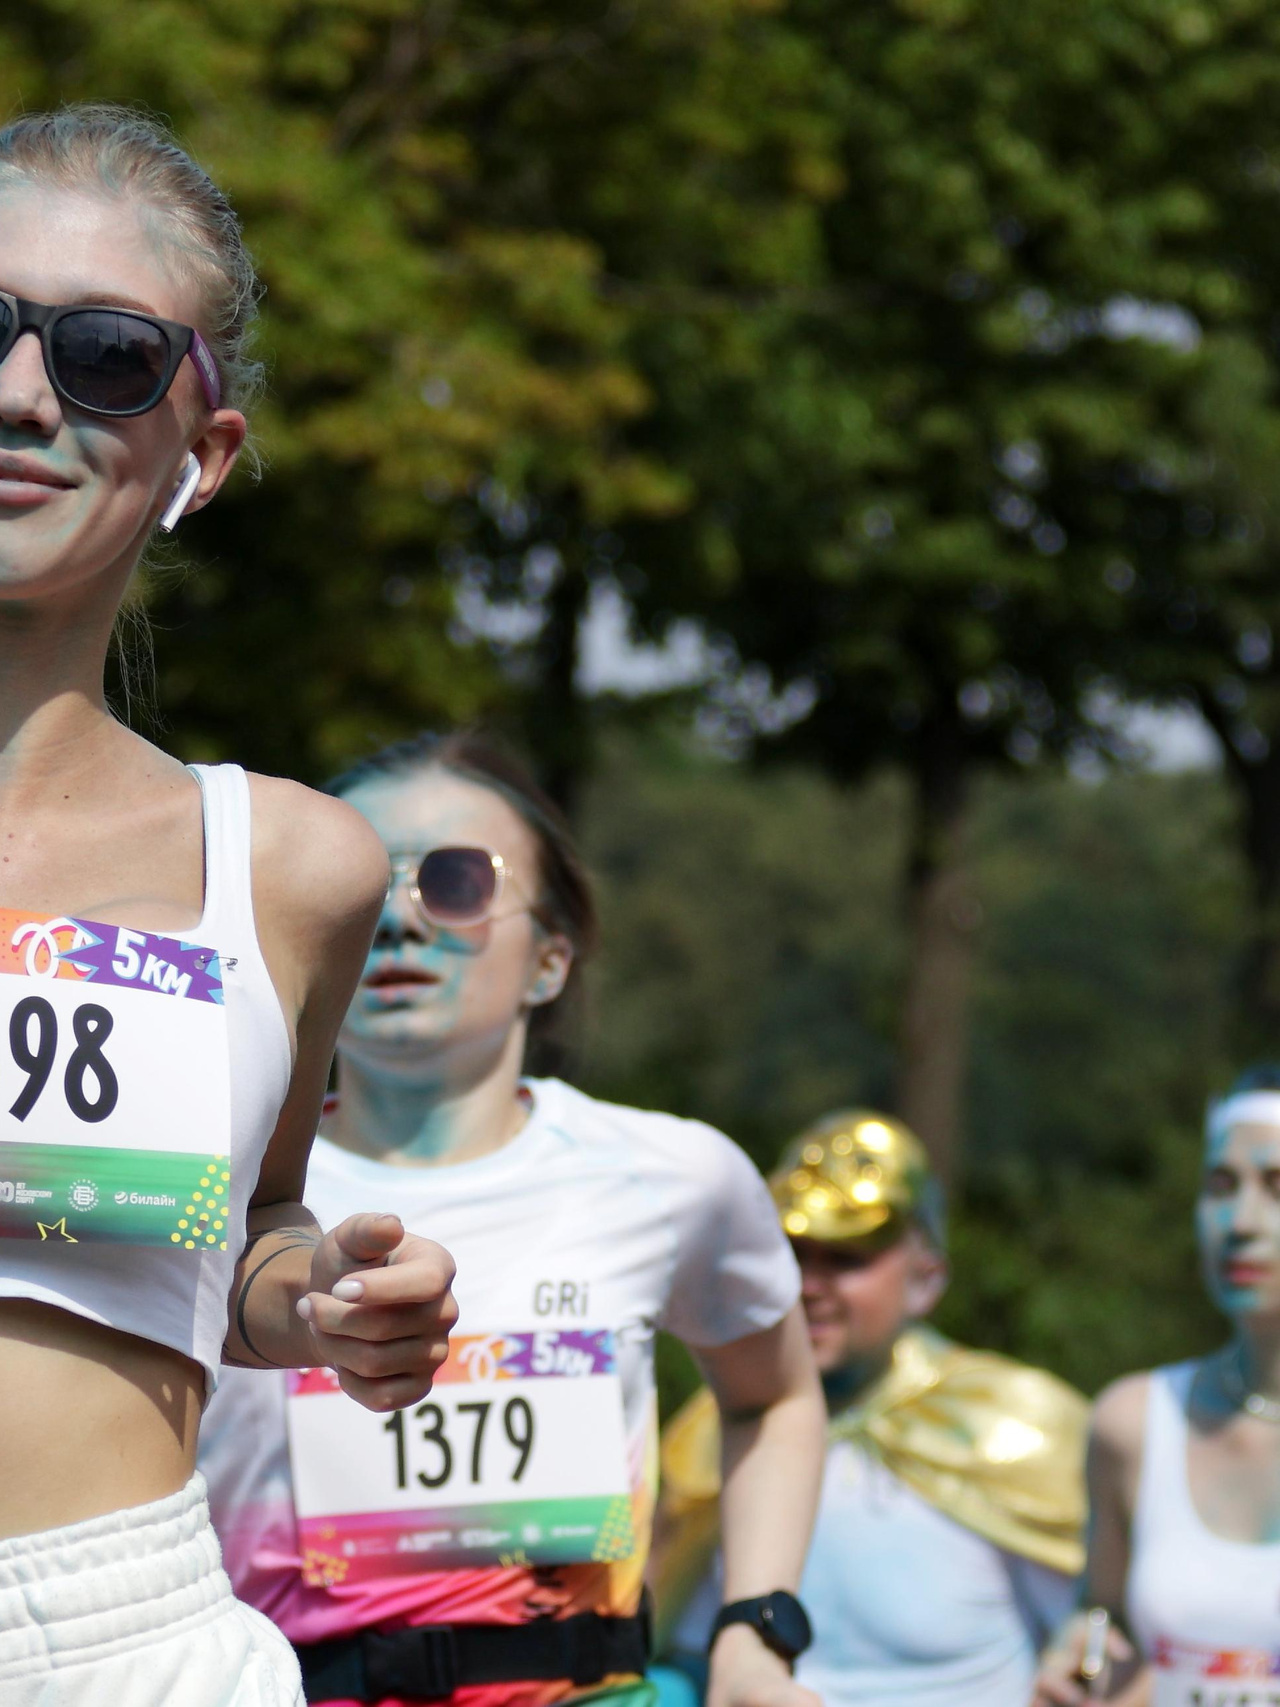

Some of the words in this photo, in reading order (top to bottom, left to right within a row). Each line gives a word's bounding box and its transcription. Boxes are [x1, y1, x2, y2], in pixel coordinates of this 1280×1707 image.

[111, 927, 147, 980] 5
[129, 1192, 176, 1207] билайн
[530, 1332, 560, 1374] 5
[384, 1396, 535, 1490] 1379
